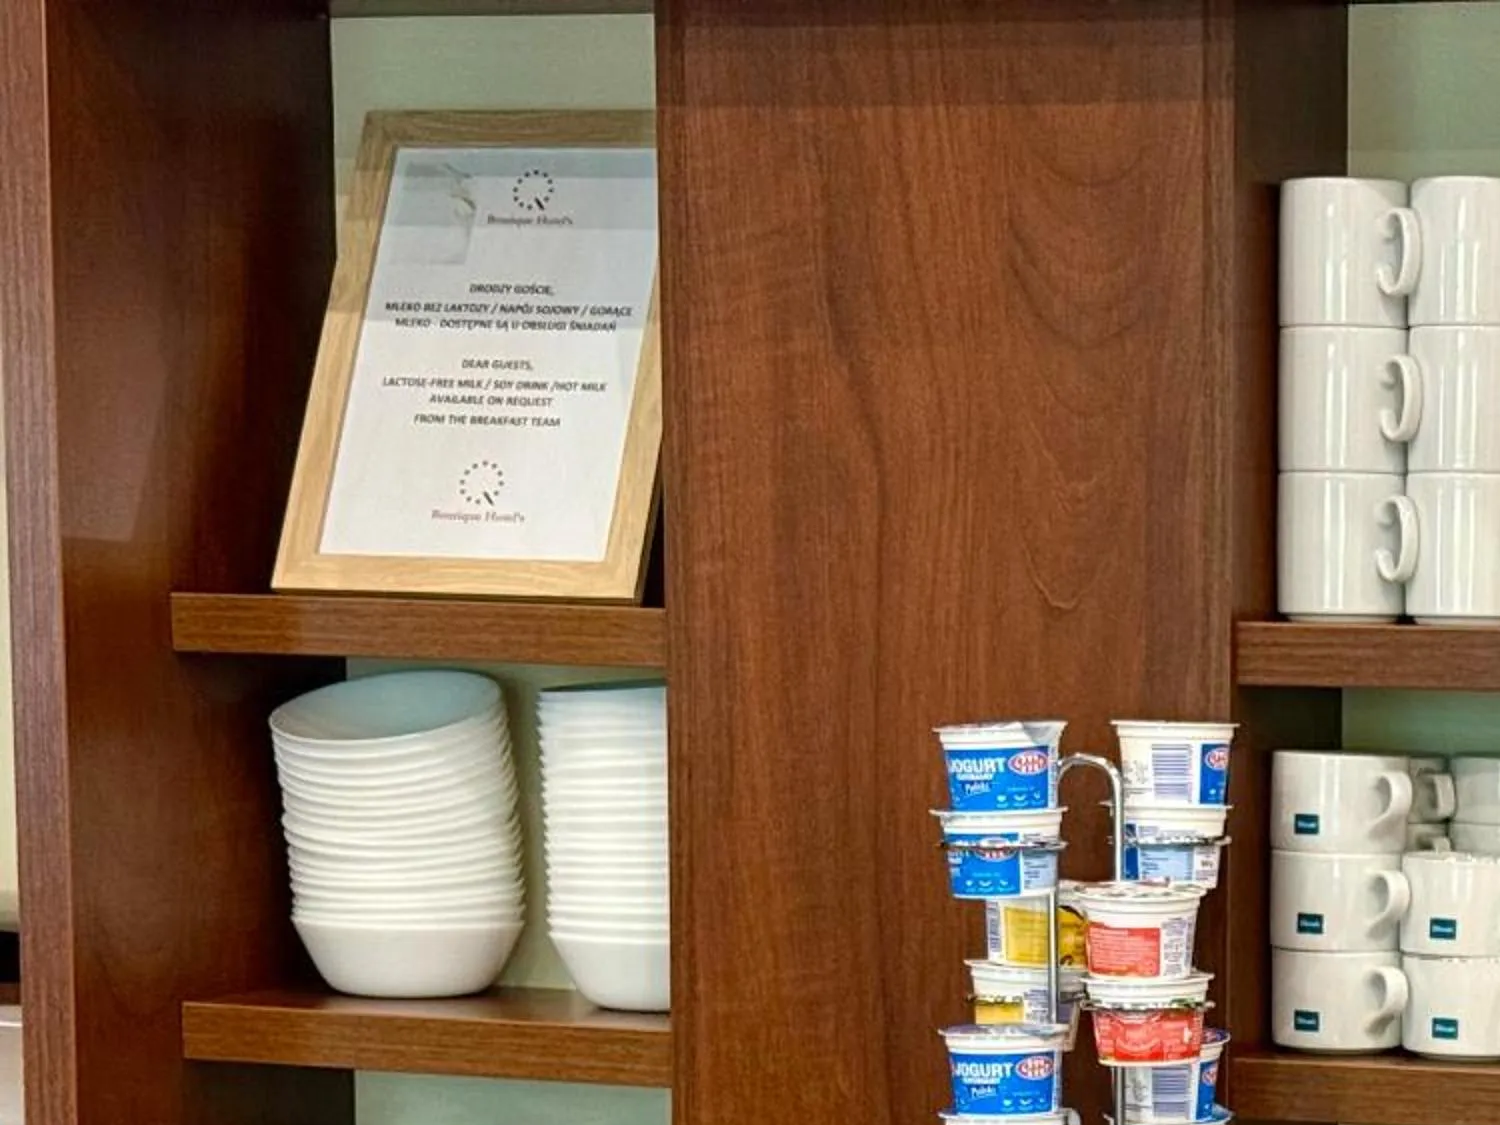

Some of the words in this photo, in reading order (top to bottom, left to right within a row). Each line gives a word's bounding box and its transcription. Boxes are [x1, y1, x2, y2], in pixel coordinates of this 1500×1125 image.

[385, 302, 421, 313] MLEKO
[461, 359, 490, 369] DEAR
[457, 379, 484, 389] MILK
[429, 394, 484, 405] AVAILABLE
[487, 395, 504, 405] ON
[505, 396, 554, 407] REQUEST
[413, 413, 445, 424] FROM
[448, 414, 467, 424] THE
[469, 415, 529, 426] BREAKFAST
[531, 416, 561, 427] TEAM
[955, 1062, 1014, 1078] JOGURT
